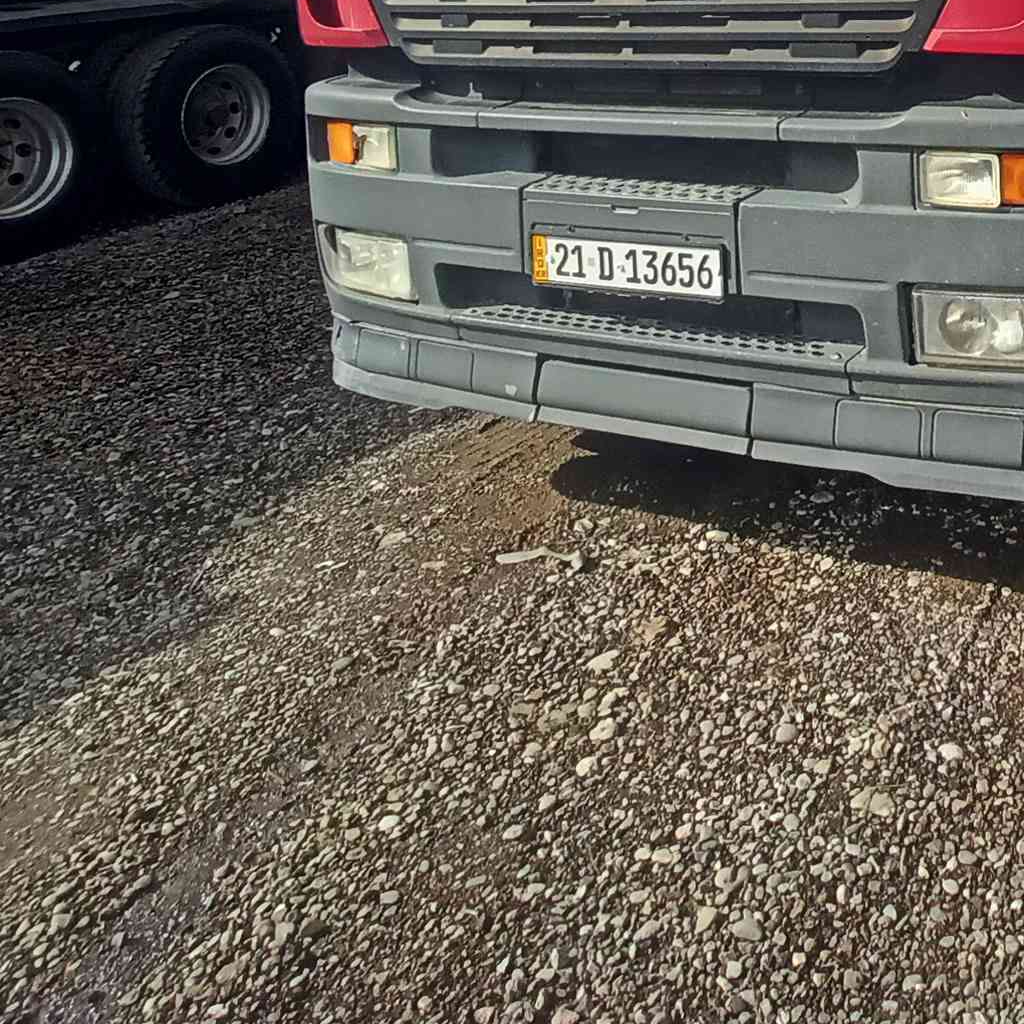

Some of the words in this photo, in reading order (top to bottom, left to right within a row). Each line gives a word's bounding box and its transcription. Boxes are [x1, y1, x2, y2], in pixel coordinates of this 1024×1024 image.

[554, 243, 587, 278] 21
[598, 246, 614, 281] D
[625, 249, 713, 289] 13656
